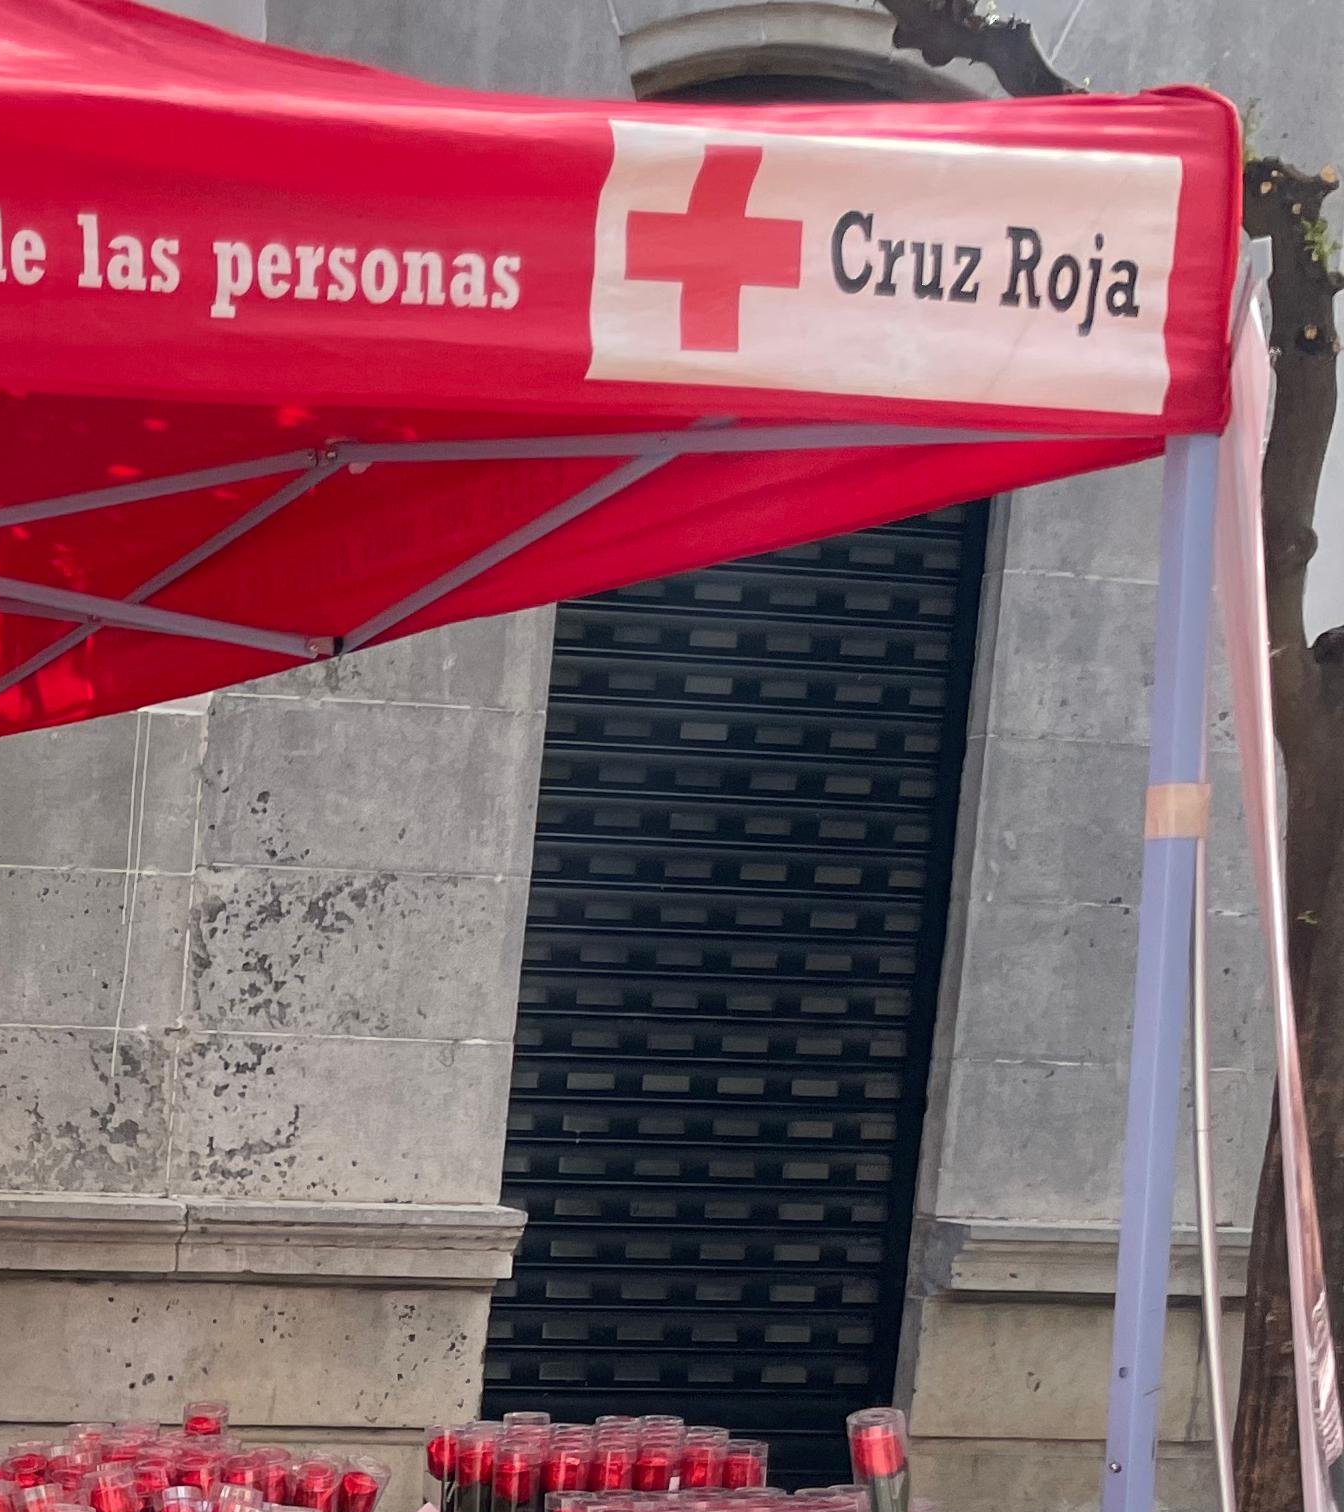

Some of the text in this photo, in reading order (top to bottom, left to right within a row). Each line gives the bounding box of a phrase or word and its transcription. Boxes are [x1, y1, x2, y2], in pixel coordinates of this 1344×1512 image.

[78, 213, 180, 293] las
[210, 239, 521, 317] personas
[830, 210, 1141, 336] Cruz Roja
